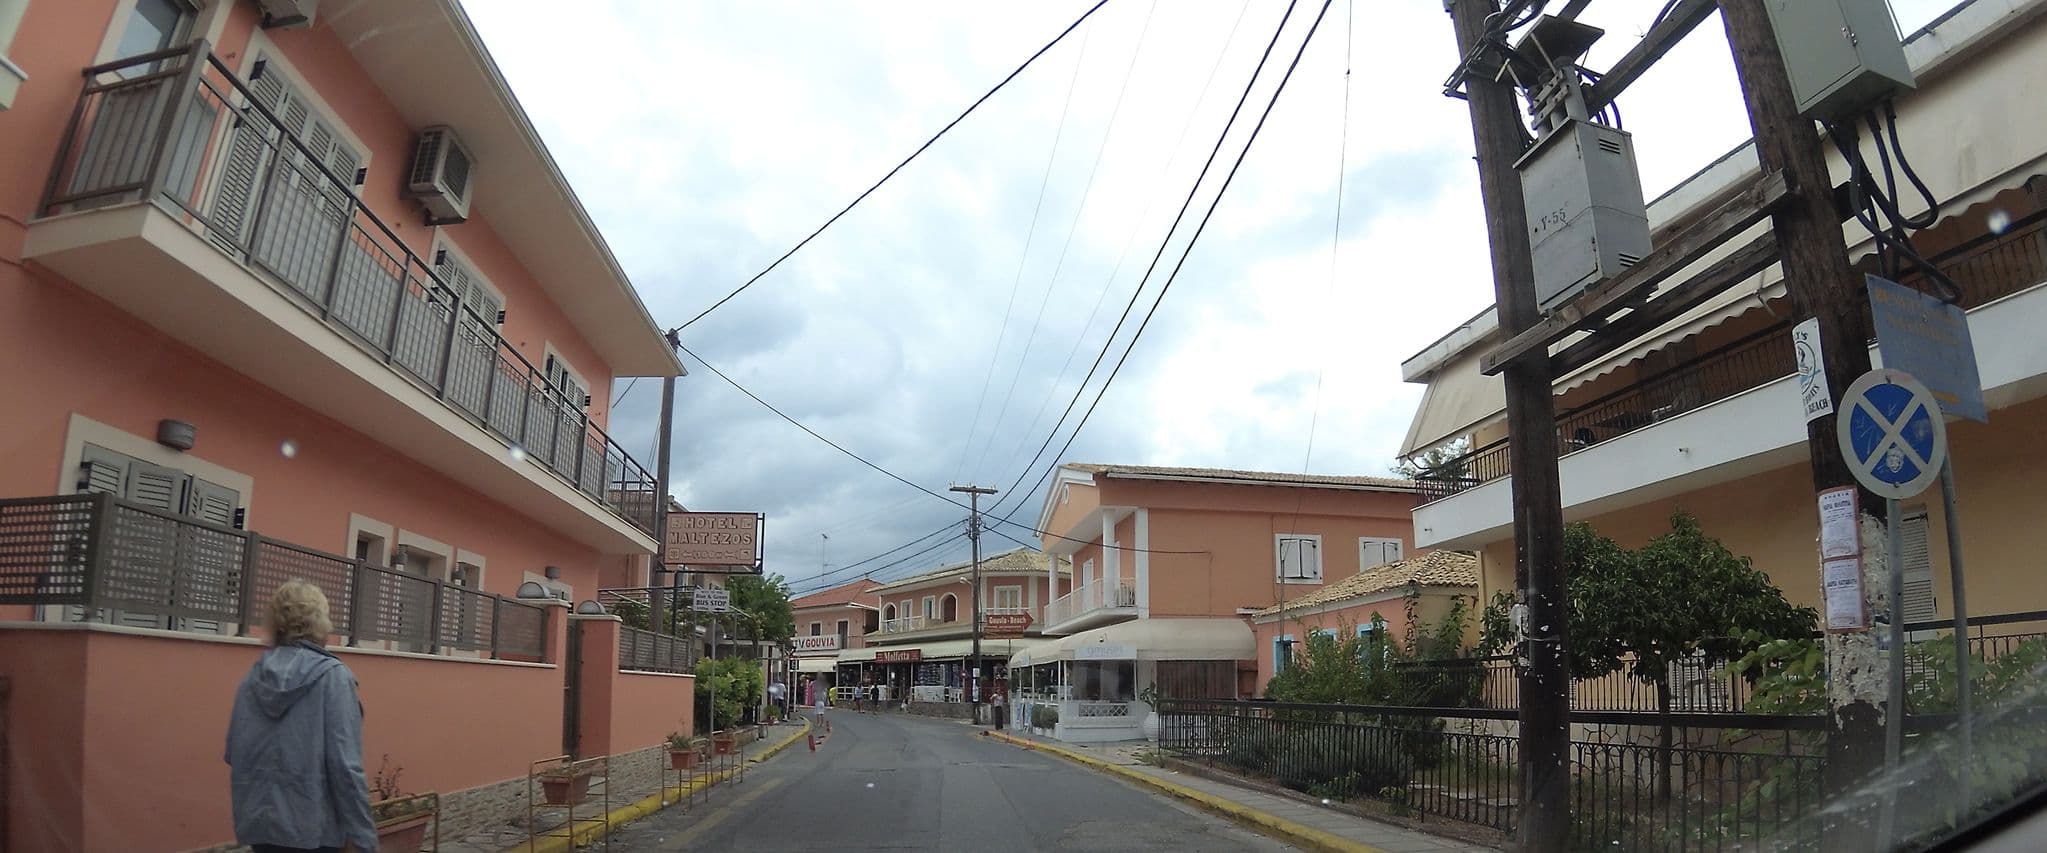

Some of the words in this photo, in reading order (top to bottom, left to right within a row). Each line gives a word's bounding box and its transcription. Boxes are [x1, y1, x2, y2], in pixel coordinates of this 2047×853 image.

[685, 517, 737, 529] HOTEL
[669, 531, 752, 545] MALTEZOS
[805, 637, 835, 648] GOUVIA
